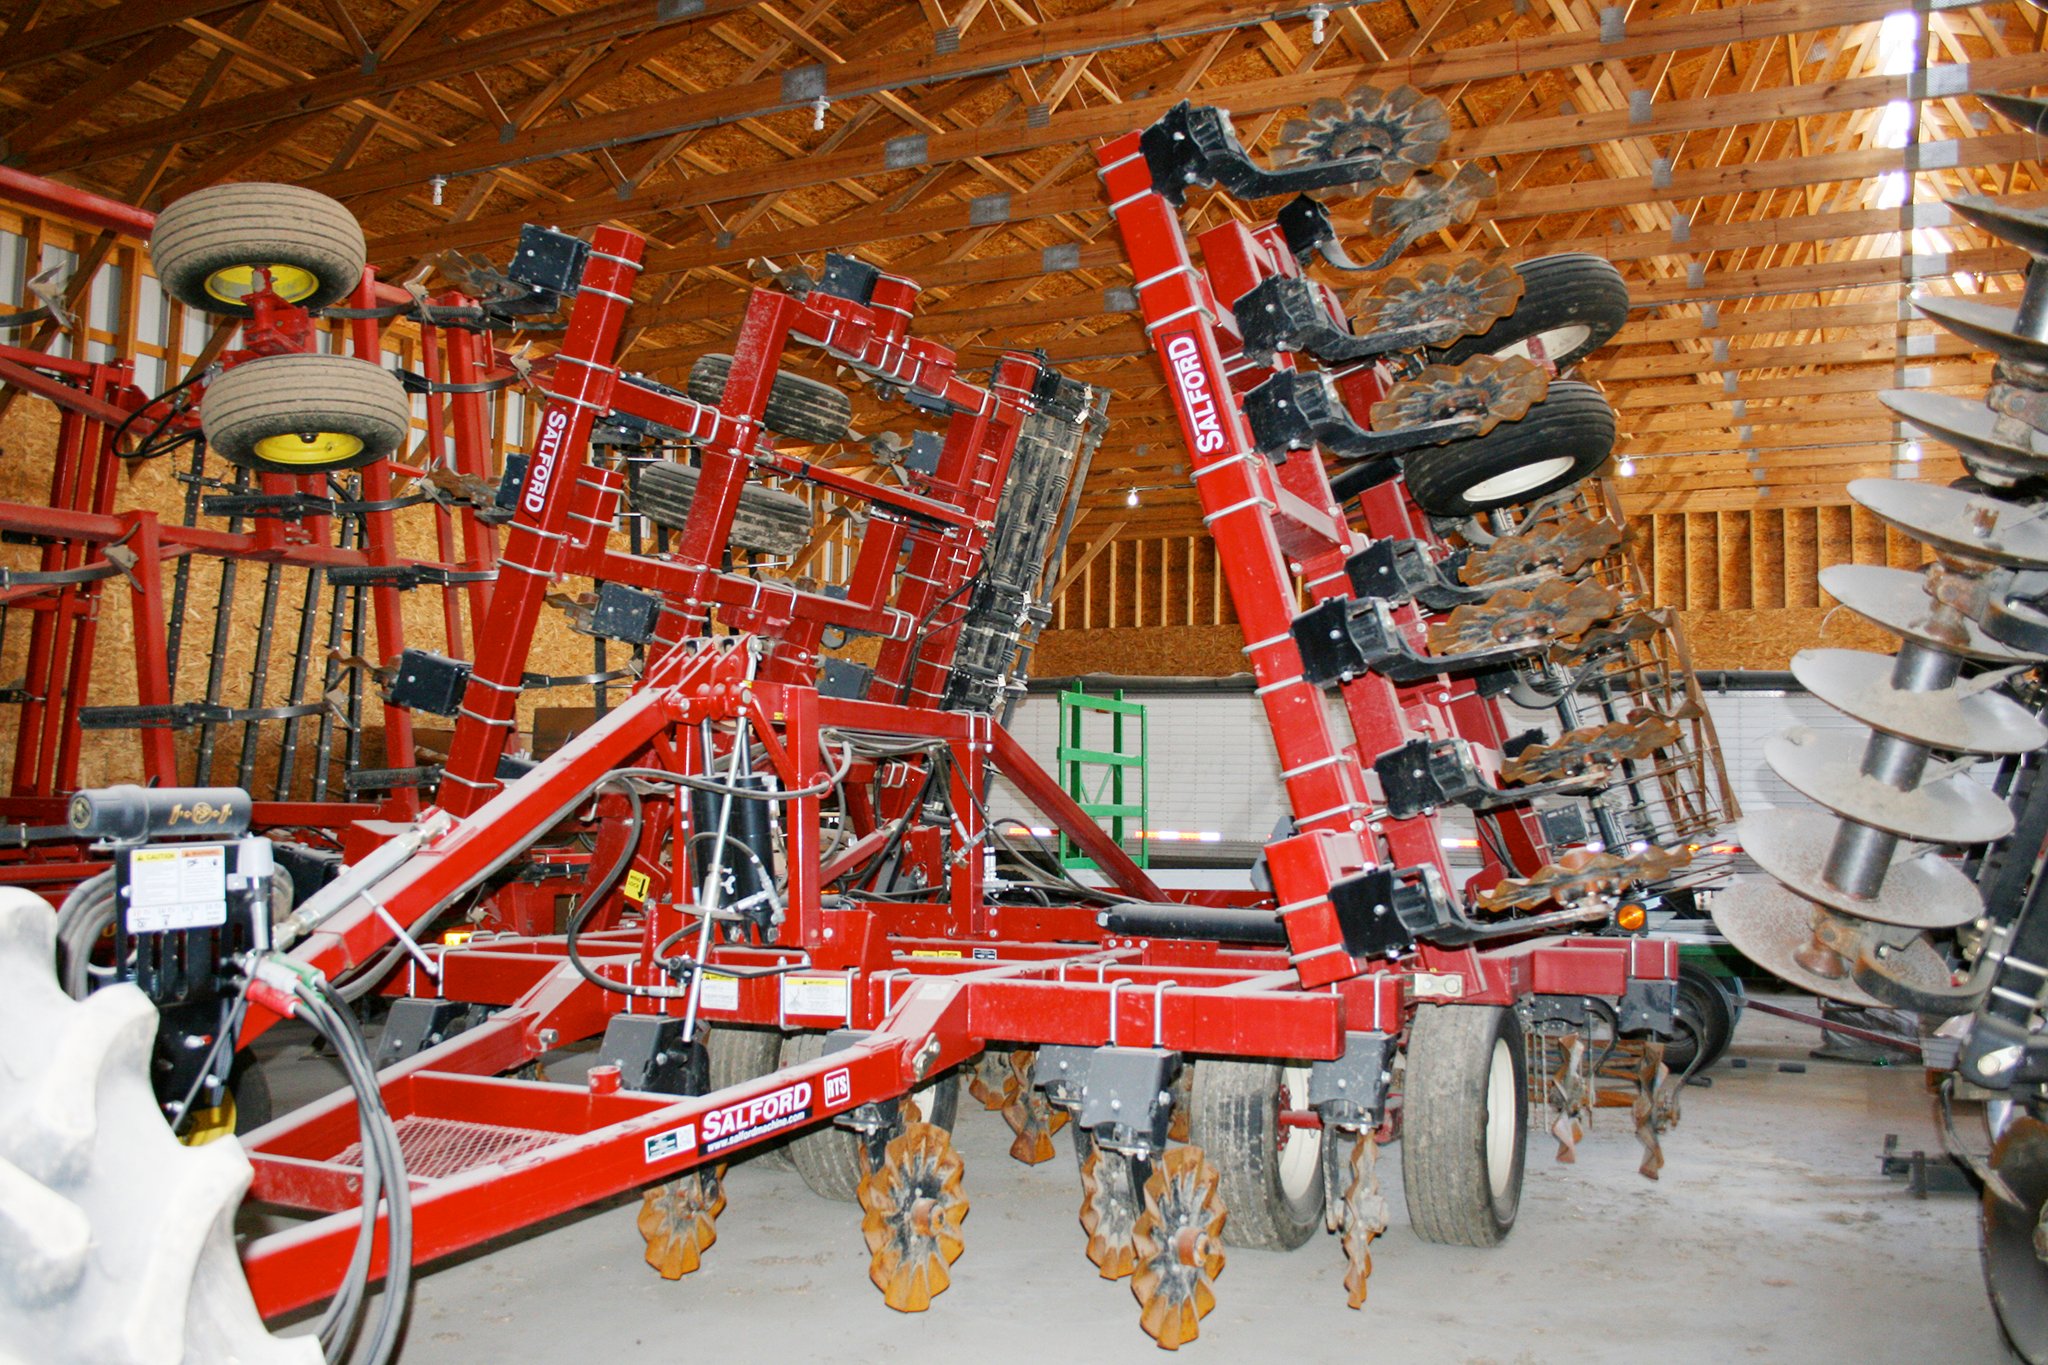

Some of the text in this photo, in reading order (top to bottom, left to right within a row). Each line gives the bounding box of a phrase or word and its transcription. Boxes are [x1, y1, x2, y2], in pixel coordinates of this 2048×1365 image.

[1168, 336, 1224, 453] SALFORD
[525, 411, 567, 512] SALFORD
[702, 1082, 812, 1141] SALFORD
[826, 1073, 847, 1099] RTS
[707, 1111, 805, 1152] www.salfordmachine.com
